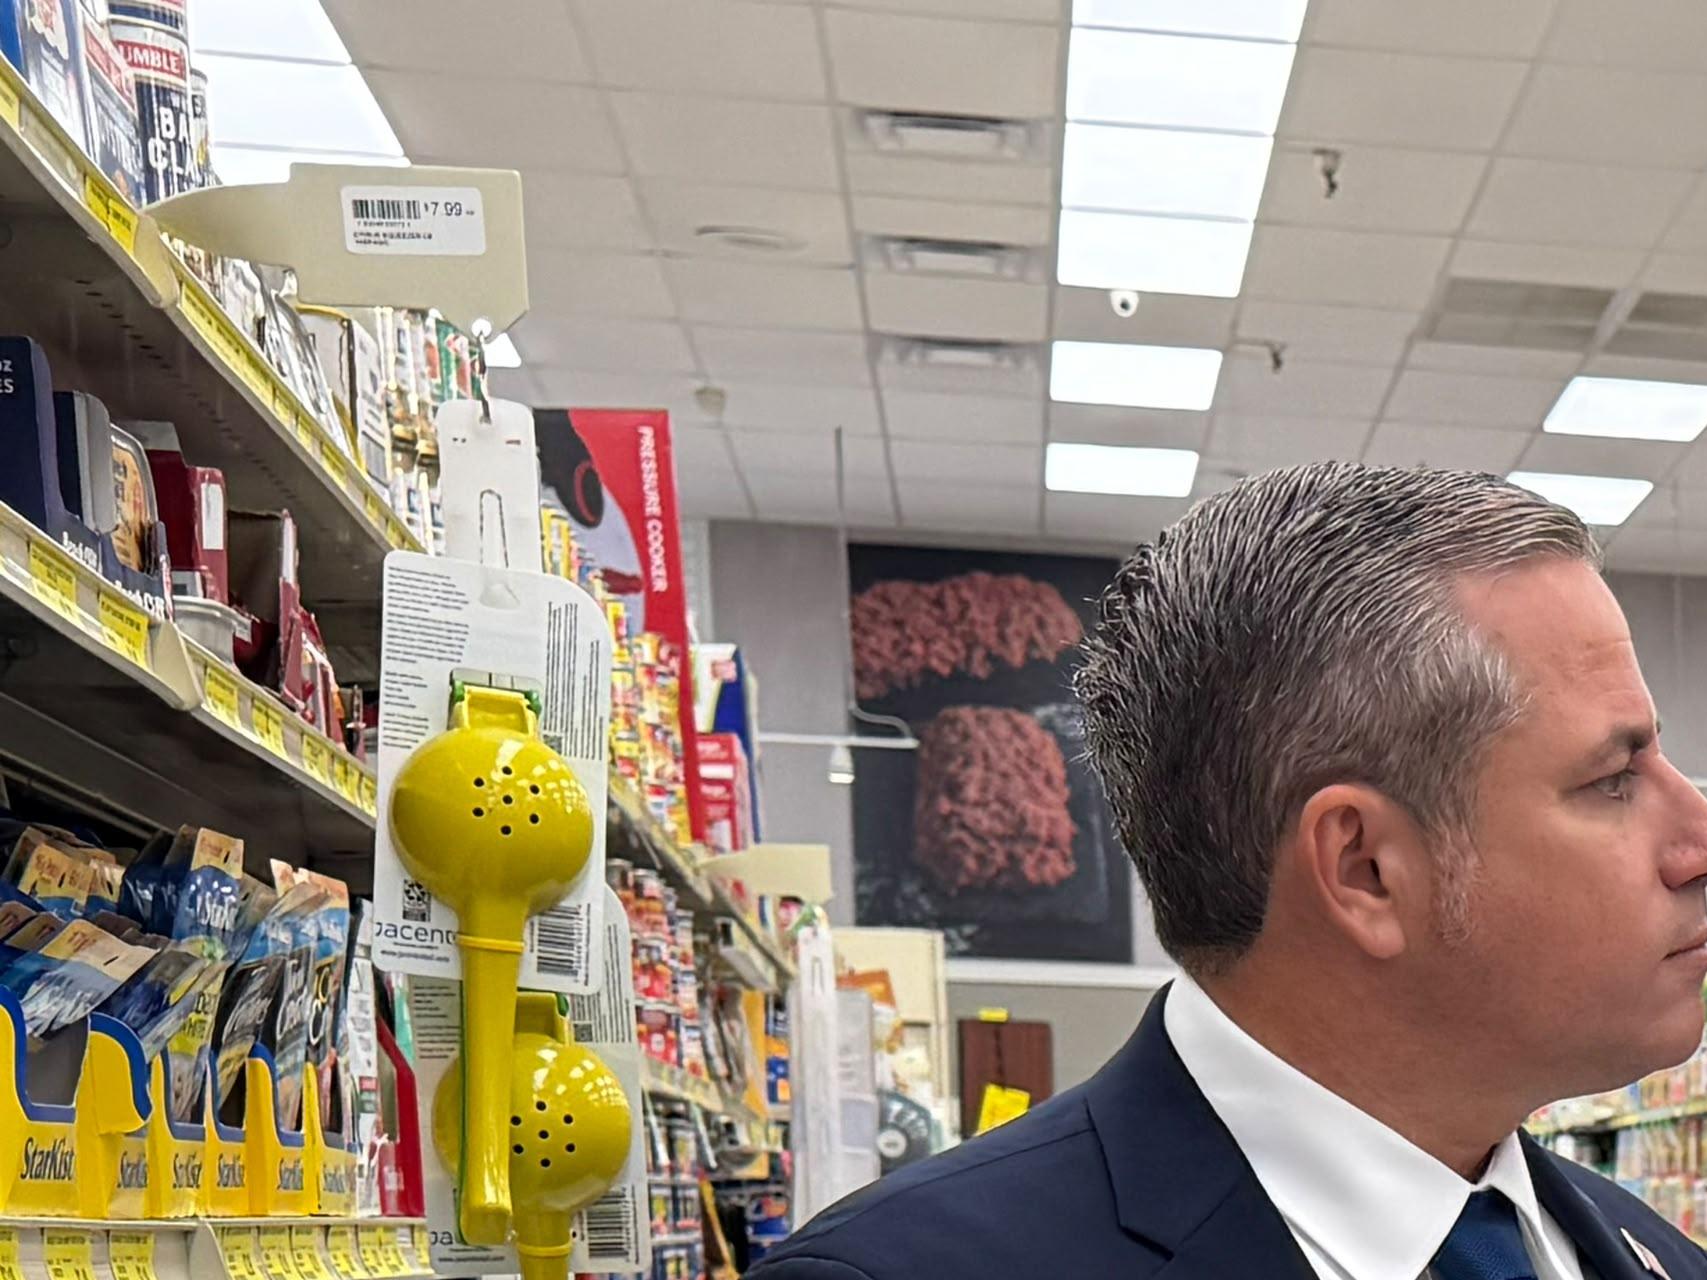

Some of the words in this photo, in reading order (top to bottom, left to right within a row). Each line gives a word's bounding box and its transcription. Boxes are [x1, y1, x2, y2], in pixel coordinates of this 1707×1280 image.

[119, 43, 182, 76] UMBLE
[636, 425, 664, 515] PRESSURE
[644, 517, 666, 592] COOKER
[20, 1136, 75, 1181] StarKist
